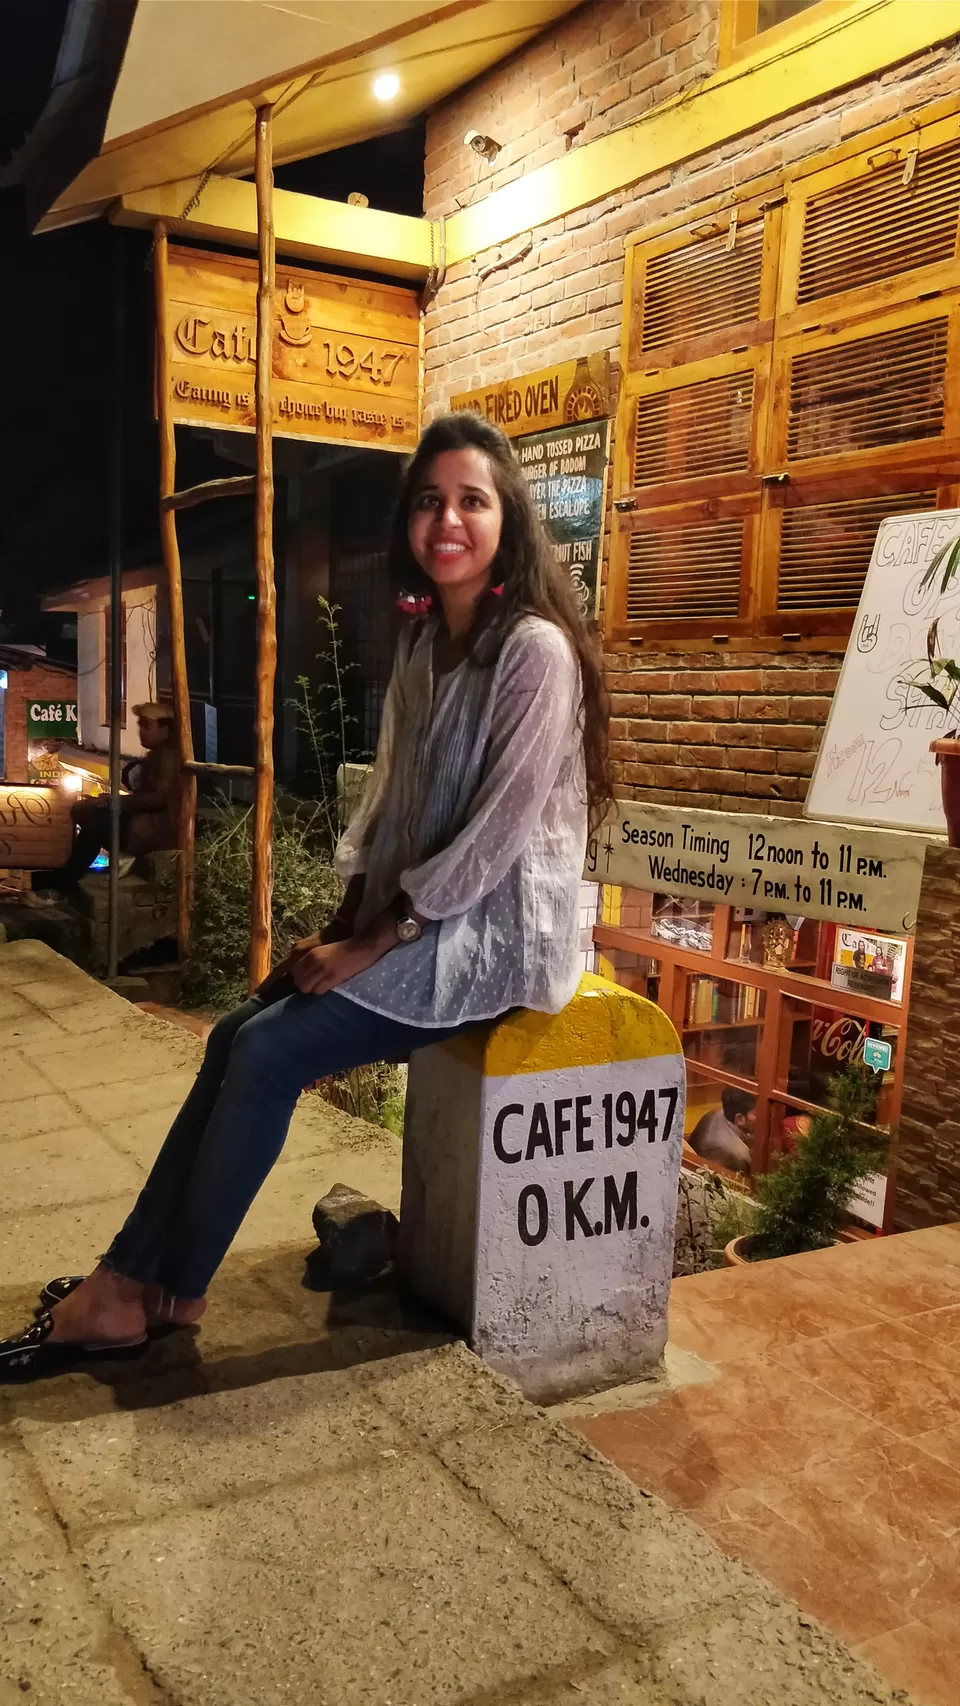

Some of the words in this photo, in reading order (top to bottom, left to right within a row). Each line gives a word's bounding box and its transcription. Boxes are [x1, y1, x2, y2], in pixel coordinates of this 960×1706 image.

[323, 339, 405, 387] 1947
[485, 389, 522, 425] FIRED
[525, 375, 559, 418] OVEN
[521, 443, 544, 463] HAND
[546, 439, 573, 458] TOSSED
[575, 433, 601, 453] PIZZA
[548, 480, 560, 498] THE
[560, 475, 587, 494] PIZZA
[549, 460, 558, 476] OF
[549, 498, 590, 520] ESCALOPE
[573, 540, 592, 562] FISH
[876, 518, 956, 568] CAFE
[30, 704, 63, 722] Café
[65, 704, 78, 722] K
[621, 820, 674, 848] Season
[681, 824, 730, 863] Timing
[811, 841, 829, 870] to
[839, 844, 852, 873] 11
[856, 858, 887, 878] P.M.
[648, 854, 734, 896] Wednesday
[751, 868, 763, 895] 7
[764, 880, 790, 900] P.M.
[794, 875, 811, 903] to
[819, 877, 832, 906] 11
[837, 890, 867, 912] P.M.
[835, 966, 851, 978] RIGHT
[493, 1095, 594, 1164] CAFE
[602, 1086, 678, 1149] 1947
[563, 1170, 650, 1242] K.M.
